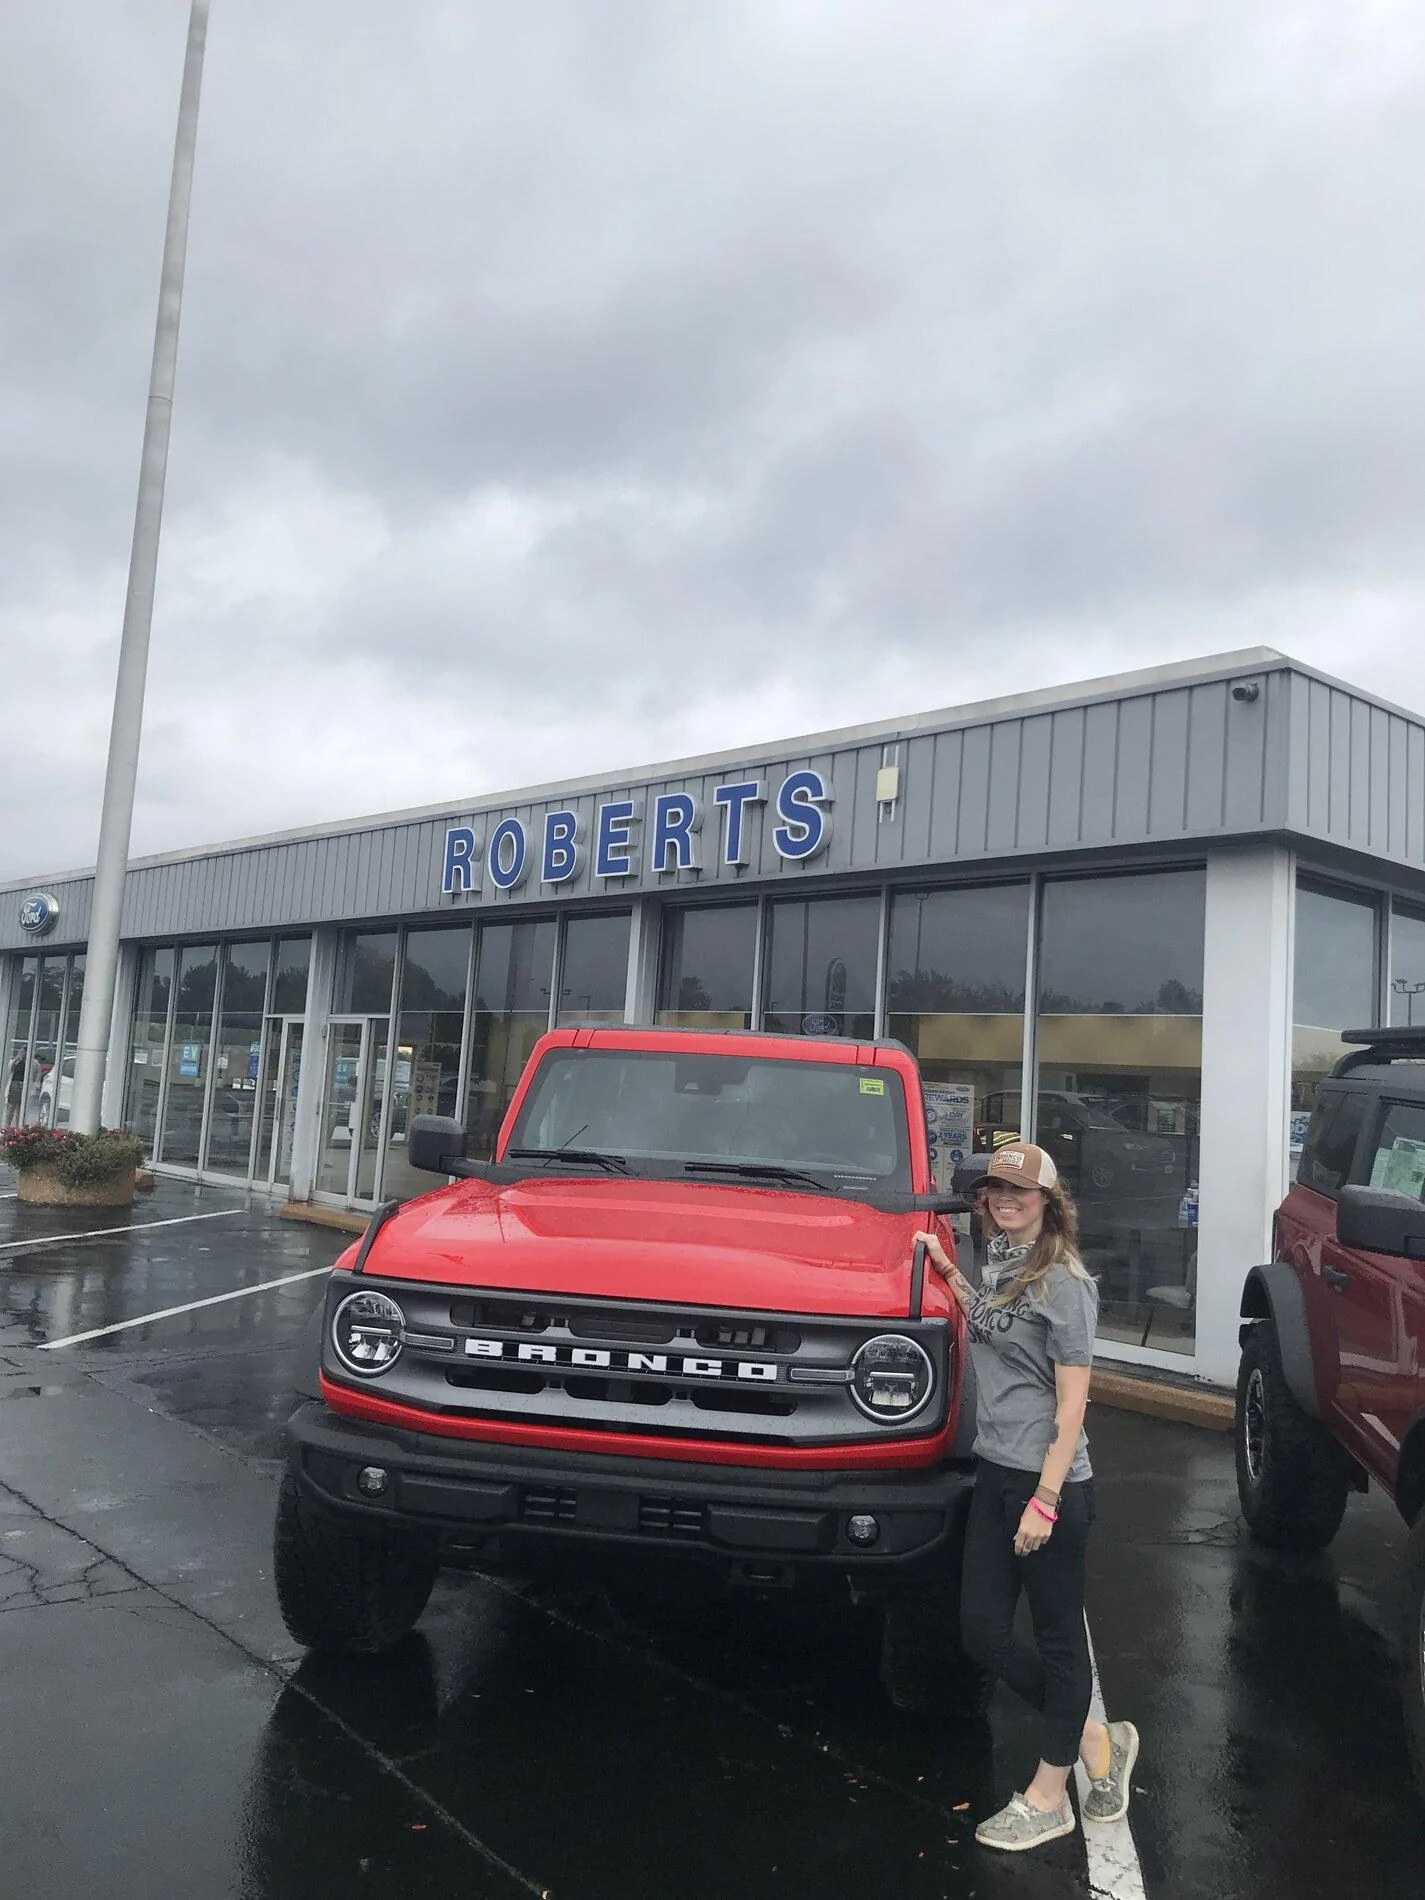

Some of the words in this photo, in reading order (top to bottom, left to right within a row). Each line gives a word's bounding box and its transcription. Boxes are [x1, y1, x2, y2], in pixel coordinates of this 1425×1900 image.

[442, 769, 834, 894] ROBERTS
[21, 902, 41, 925] Ford
[183, 1046, 198, 1059] EV
[938, 1131, 943, 1139] 2
[944, 1131, 967, 1140] YEARS
[969, 1297, 1013, 1333] ONCO
[464, 1338, 778, 1382] BRONCO
